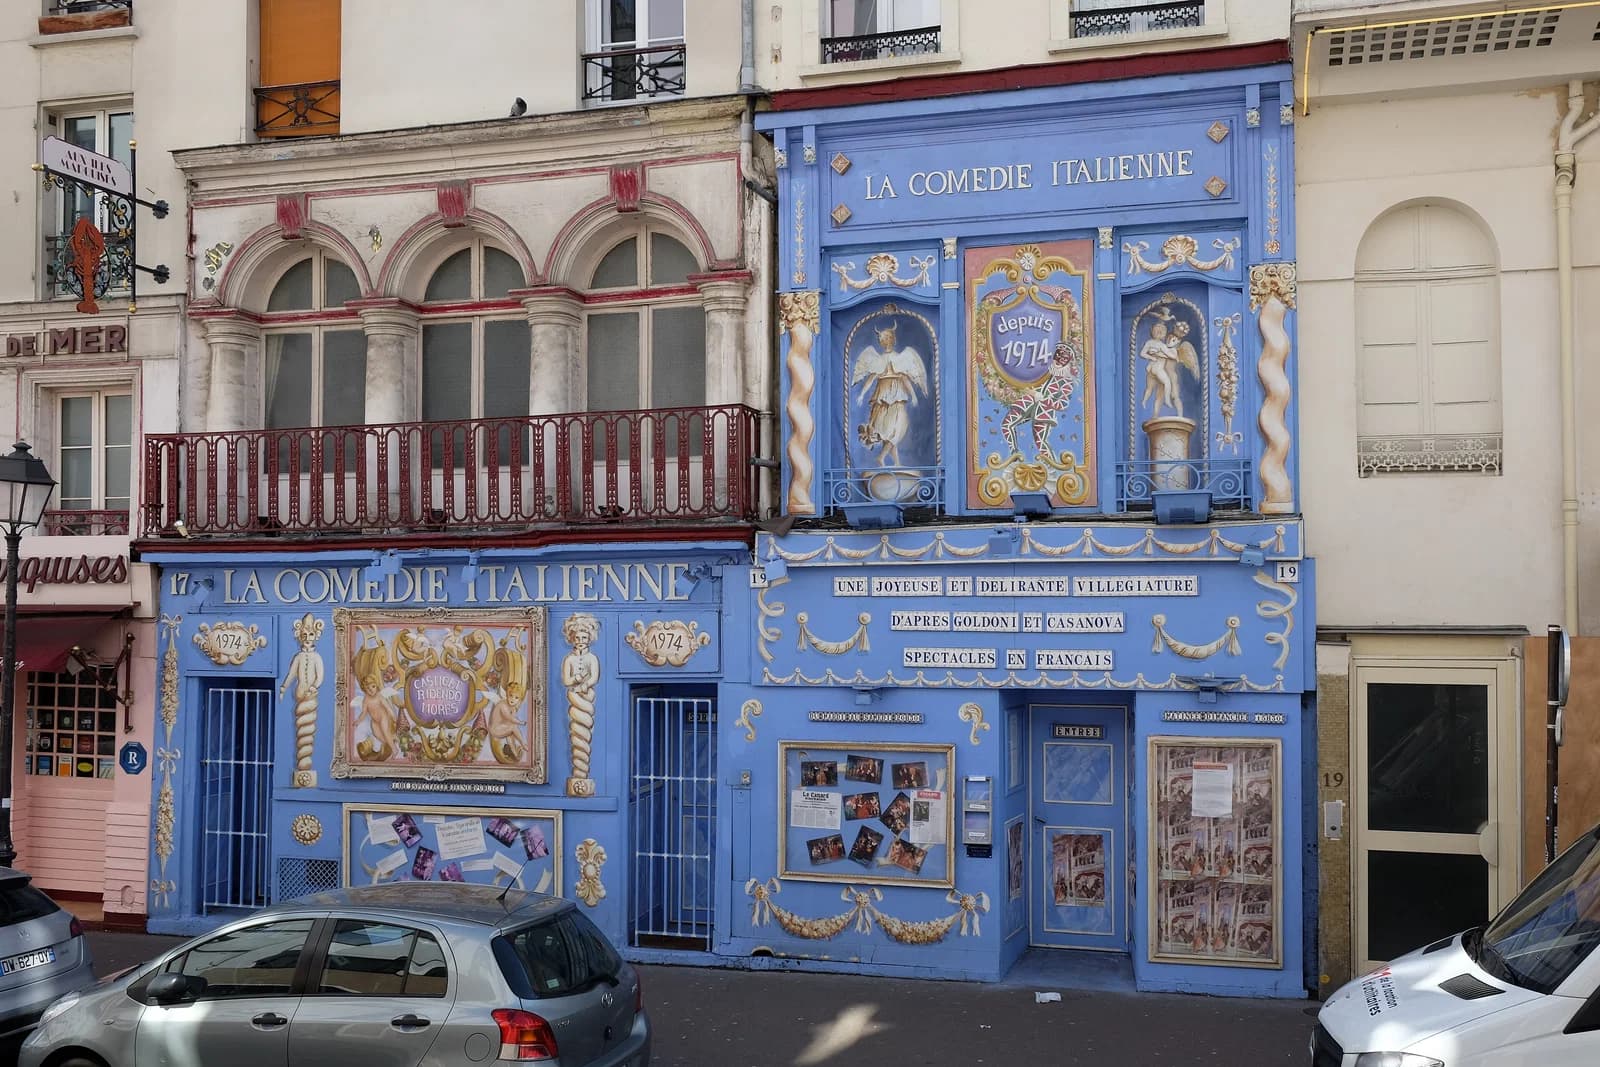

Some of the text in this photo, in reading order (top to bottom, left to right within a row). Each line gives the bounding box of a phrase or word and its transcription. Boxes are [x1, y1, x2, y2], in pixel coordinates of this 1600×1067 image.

[864, 150, 1194, 200] LA COMEDIE ITALIENNE
[997, 313, 1055, 335] depuis
[6, 325, 126, 357] DE MER
[1000, 338, 1053, 368] 1974
[0, 554, 128, 594] quises
[752, 573, 767, 583] 19
[1280, 566, 1296, 578] 19
[170, 572, 190, 596] 17
[223, 564, 690, 604] LA COMEDIE ITALIENNE
[837, 579, 1194, 593] UNE JOYEUSE ET DELIRANTE VILLEGIATURE
[891, 614, 1123, 630] D'APRES GOLDONI ET CASANOVA
[216, 633, 242, 650] 1974
[650, 632, 683, 652] 1974
[904, 651, 1112, 667] SPECTACLES EN FRANCAIS
[417, 689, 462, 702] RIDENDO
[421, 702, 459, 716] MORES
[1057, 727, 1098, 736] ENTREE
[1323, 772, 1344, 788] 19
